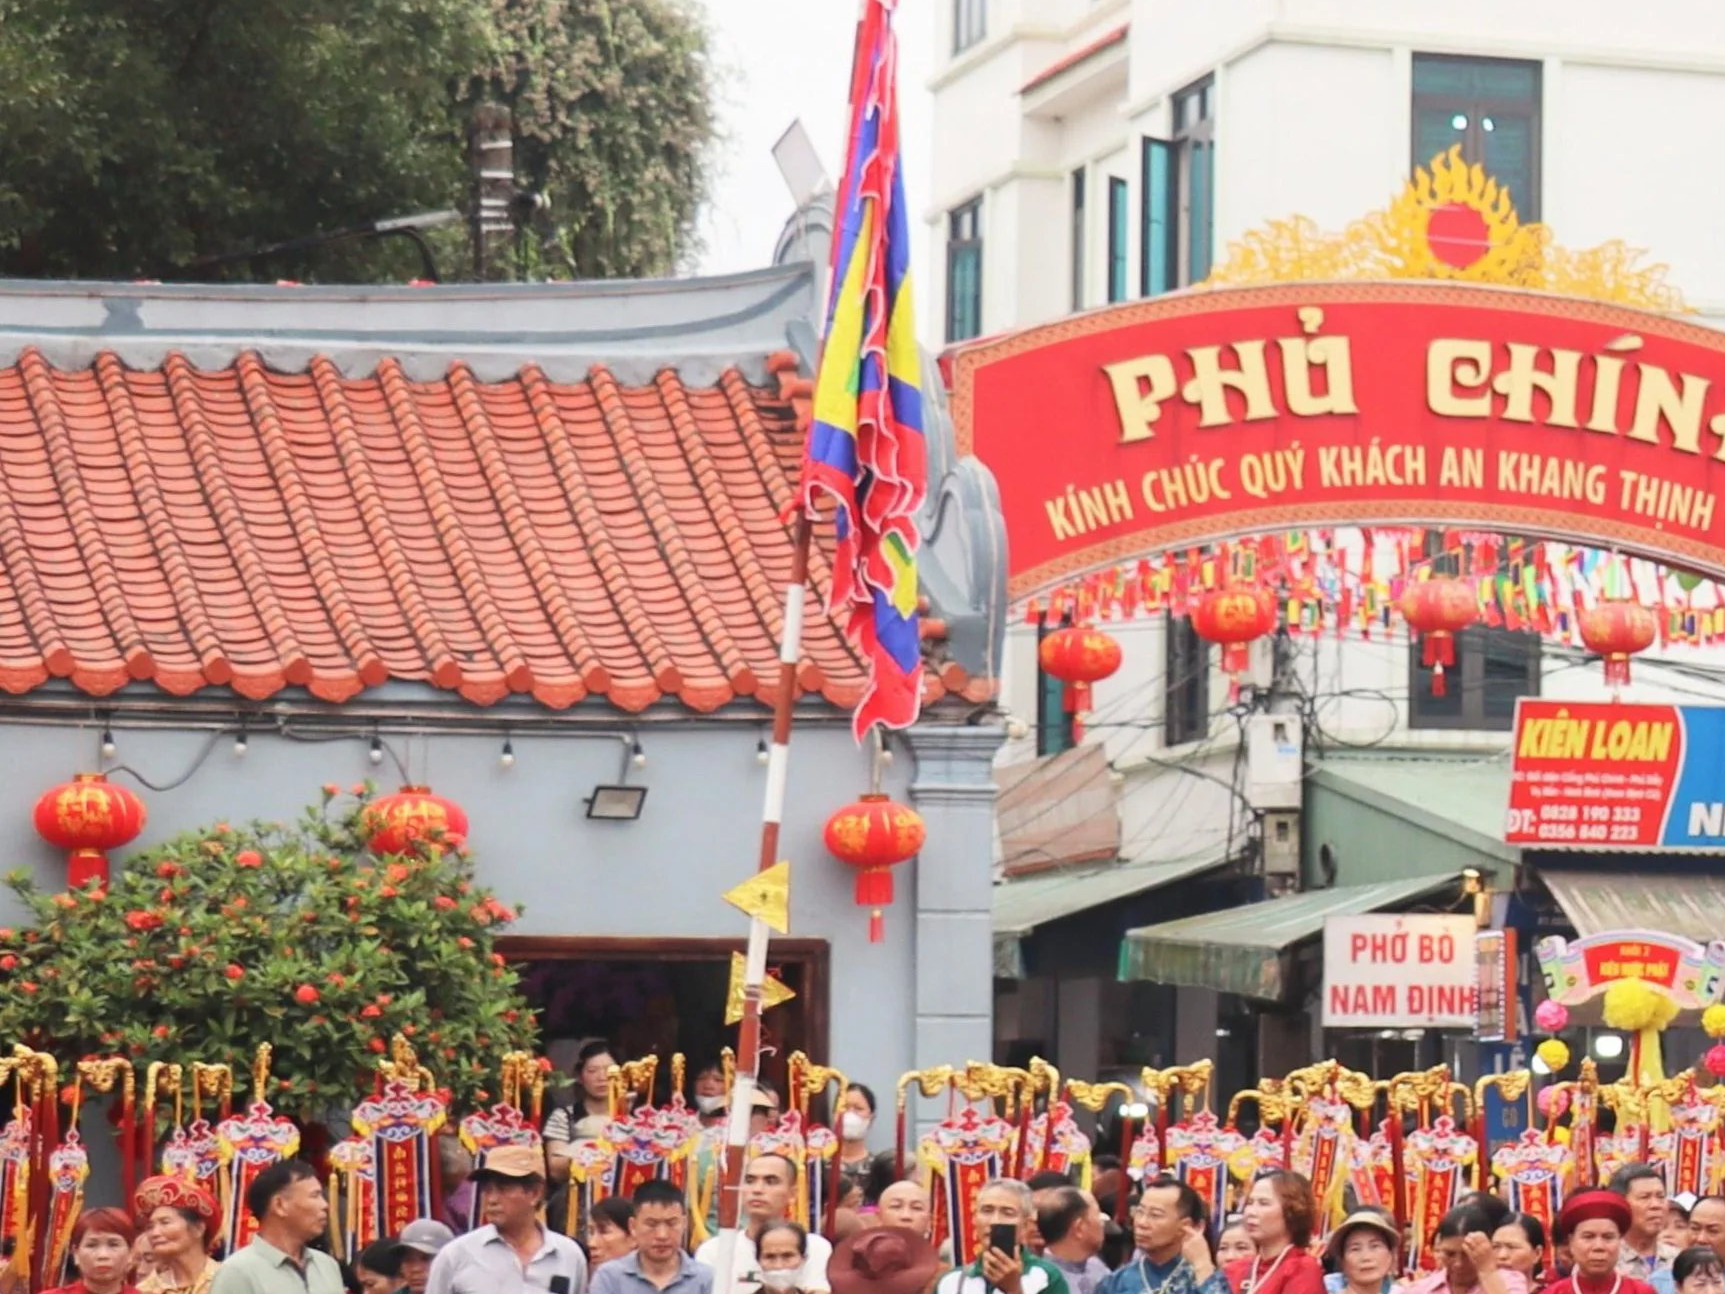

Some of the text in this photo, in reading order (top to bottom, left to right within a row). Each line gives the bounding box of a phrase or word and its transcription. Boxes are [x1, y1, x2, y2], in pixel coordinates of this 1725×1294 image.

[1100, 307, 1358, 444] PHỦ
[1046, 481, 1134, 542] KÍNH
[1141, 456, 1229, 513] CHÚC
[1240, 438, 1306, 498] QUÝ
[1319, 432, 1427, 489] KHÁCH
[1441, 447, 1483, 489] AN
[1498, 449, 1607, 503] KHANG
[1619, 468, 1715, 533] THỊNH
[1518, 709, 1672, 762] KIÊN LOAN
[1351, 921, 1454, 964] PHỞ BÒ
[1331, 985, 1475, 1023] NAM ĐỊNH
